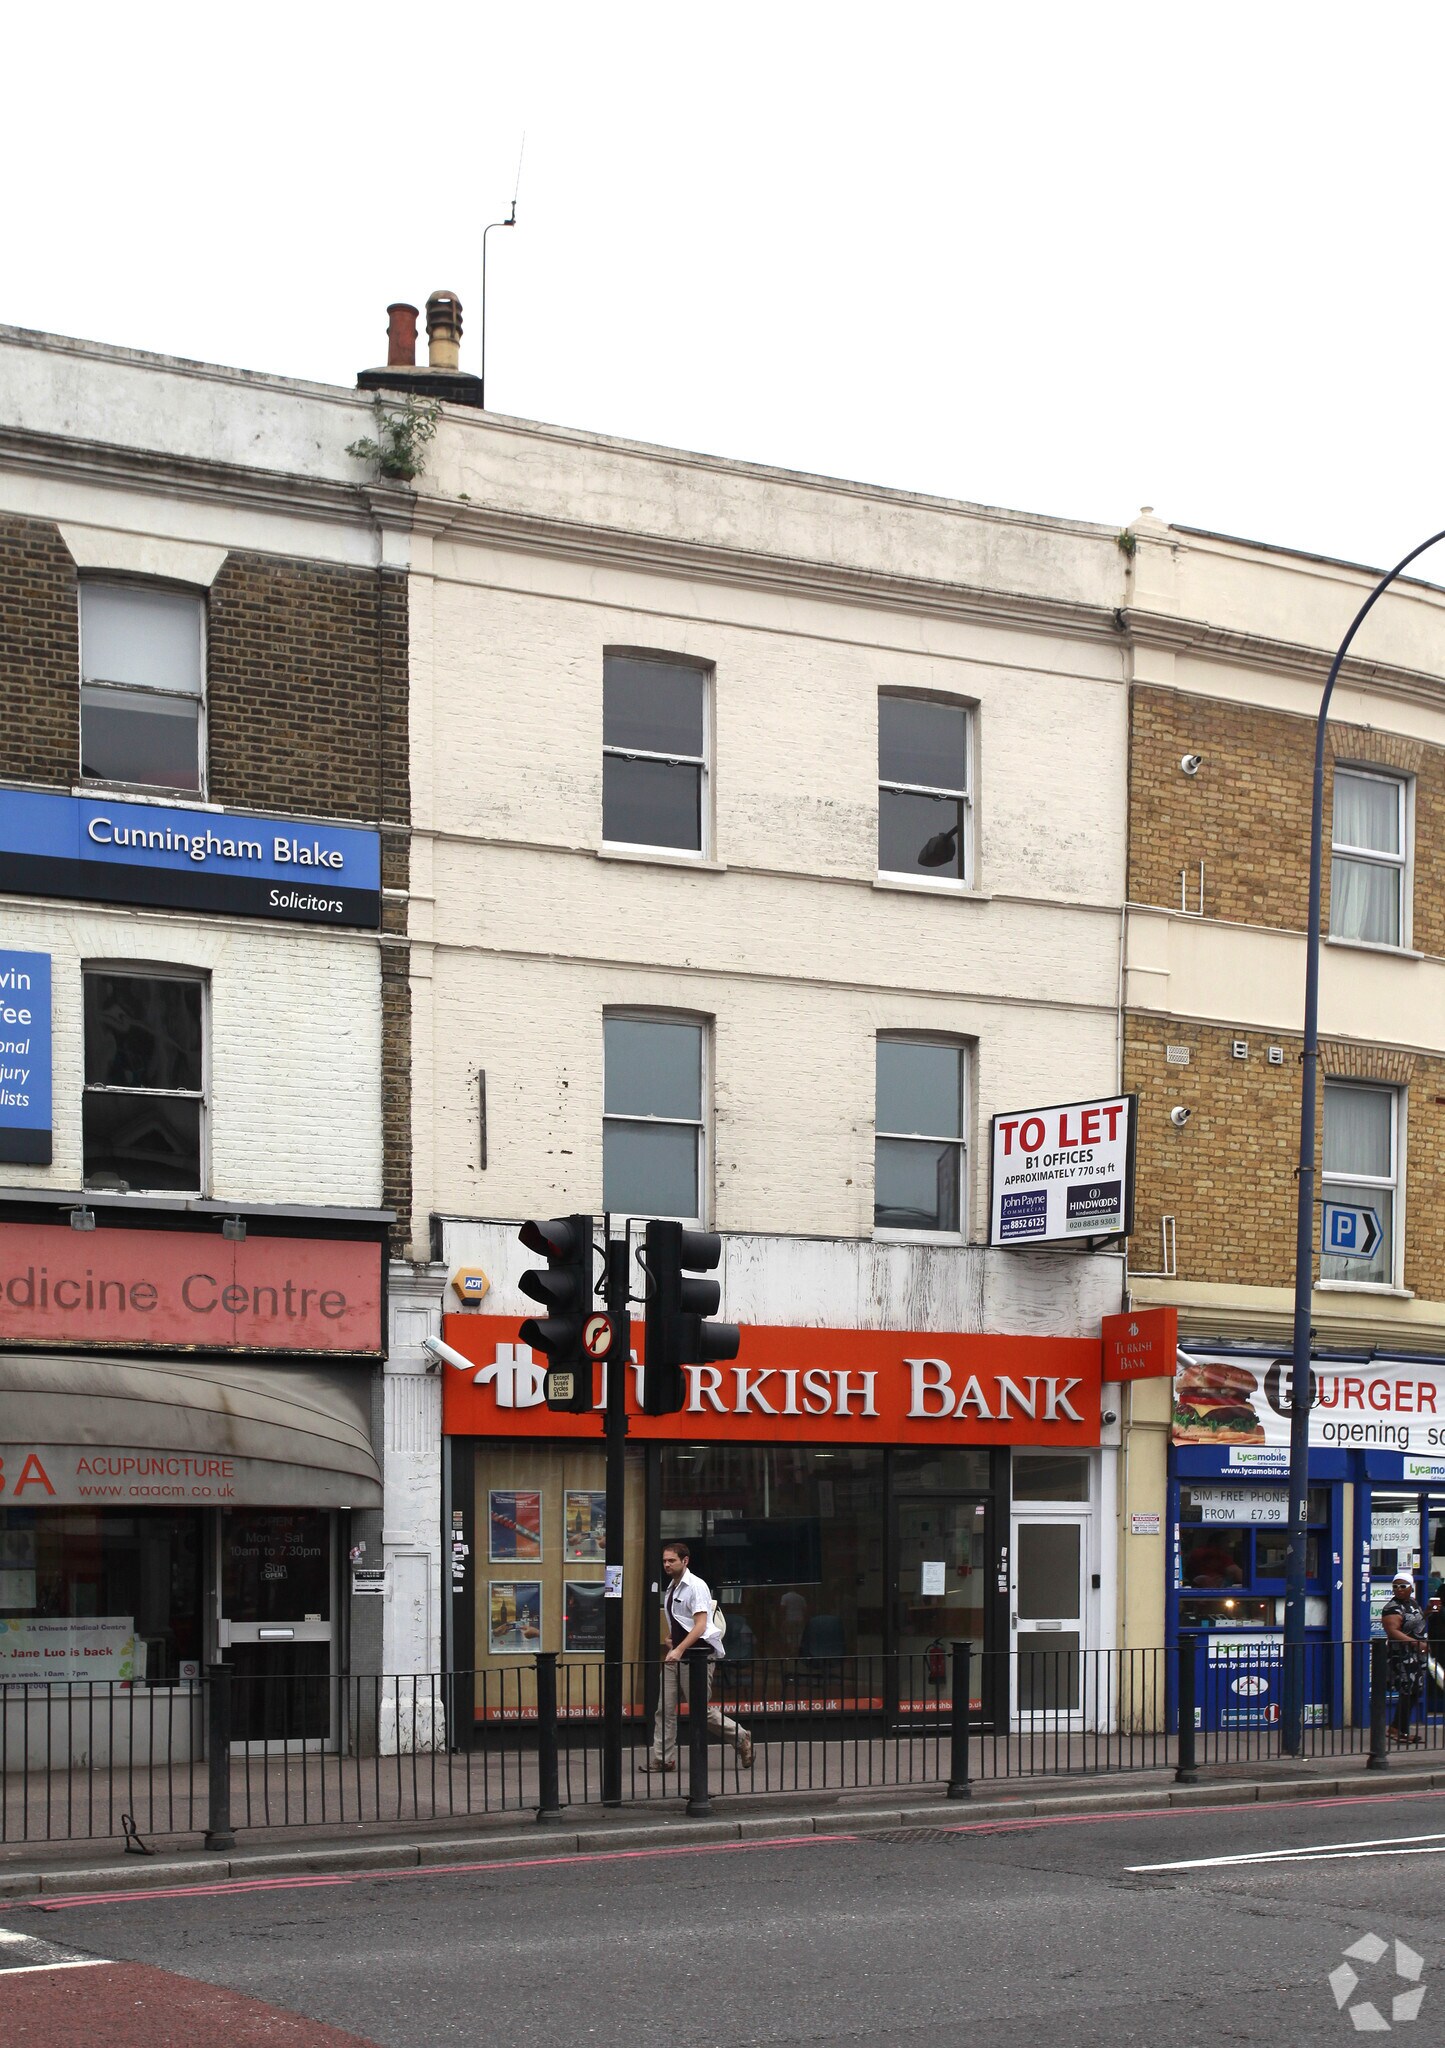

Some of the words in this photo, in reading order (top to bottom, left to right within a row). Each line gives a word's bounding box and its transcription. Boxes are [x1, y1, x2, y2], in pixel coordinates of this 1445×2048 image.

[87, 817, 262, 861] Cunningham
[273, 837, 344, 868] Blake
[269, 889, 343, 913] Solicitors
[999, 1117, 1046, 1156] TO
[1058, 1105, 1123, 1148] LET
[1025, 1155, 1039, 1169] B1
[1043, 1149, 1093, 1167] OFFICES
[1004, 1168, 1075, 1185] APPROXIMATELY
[1078, 1166, 1094, 1176] 770
[1095, 1166, 1106, 1177] sq
[1107, 1163, 1115, 1172] ft
[1003, 1197, 1021, 1210] John
[1021, 1195, 1045, 1208] Payne
[1069, 1197, 1118, 1210] HINDWOODS
[1002, 1206, 1045, 1215] COMMERCIAL
[1075, 1207, 1112, 1216] hindwoods.co.uk
[1010, 1219, 1027, 1229] 8852
[1027, 1217, 1045, 1227] 6125
[1069, 1220, 1082, 1229] 020
[1100, 1217, 1117, 1226] 9303
[1336, 1216, 1353, 1243] P
[465, 1280, 482, 1288] ADT
[0, 1266, 158, 1312] dicine
[182, 1274, 347, 1319] Centre
[1120, 1357, 1145, 1370] BANK
[903, 1358, 1085, 1421] BANK
[1323, 1420, 1409, 1449] opening
[1237, 1452, 1286, 1463] Lycamobile
[0, 1454, 57, 1496] A
[76, 1457, 235, 1478] ACUPUNCTURE
[1194, 1490, 1213, 1501] SIM
[1220, 1491, 1244, 1501] FREE
[1250, 1491, 1290, 1502] PHONES
[1204, 1508, 1235, 1519] FROM
[246, 1532, 271, 1543] Mon
[284, 1532, 304, 1543] Sat
[231, 1546, 260, 1556] 10am
[264, 1546, 275, 1556] to
[279, 1545, 321, 1558] 7.30pm
[264, 1563, 287, 1572] Sun
[11, 1649, 40, 1658] Jane
[44, 1648, 66, 1657] Luo
[70, 1647, 80, 1657] is
[84, 1647, 113, 1657] back
